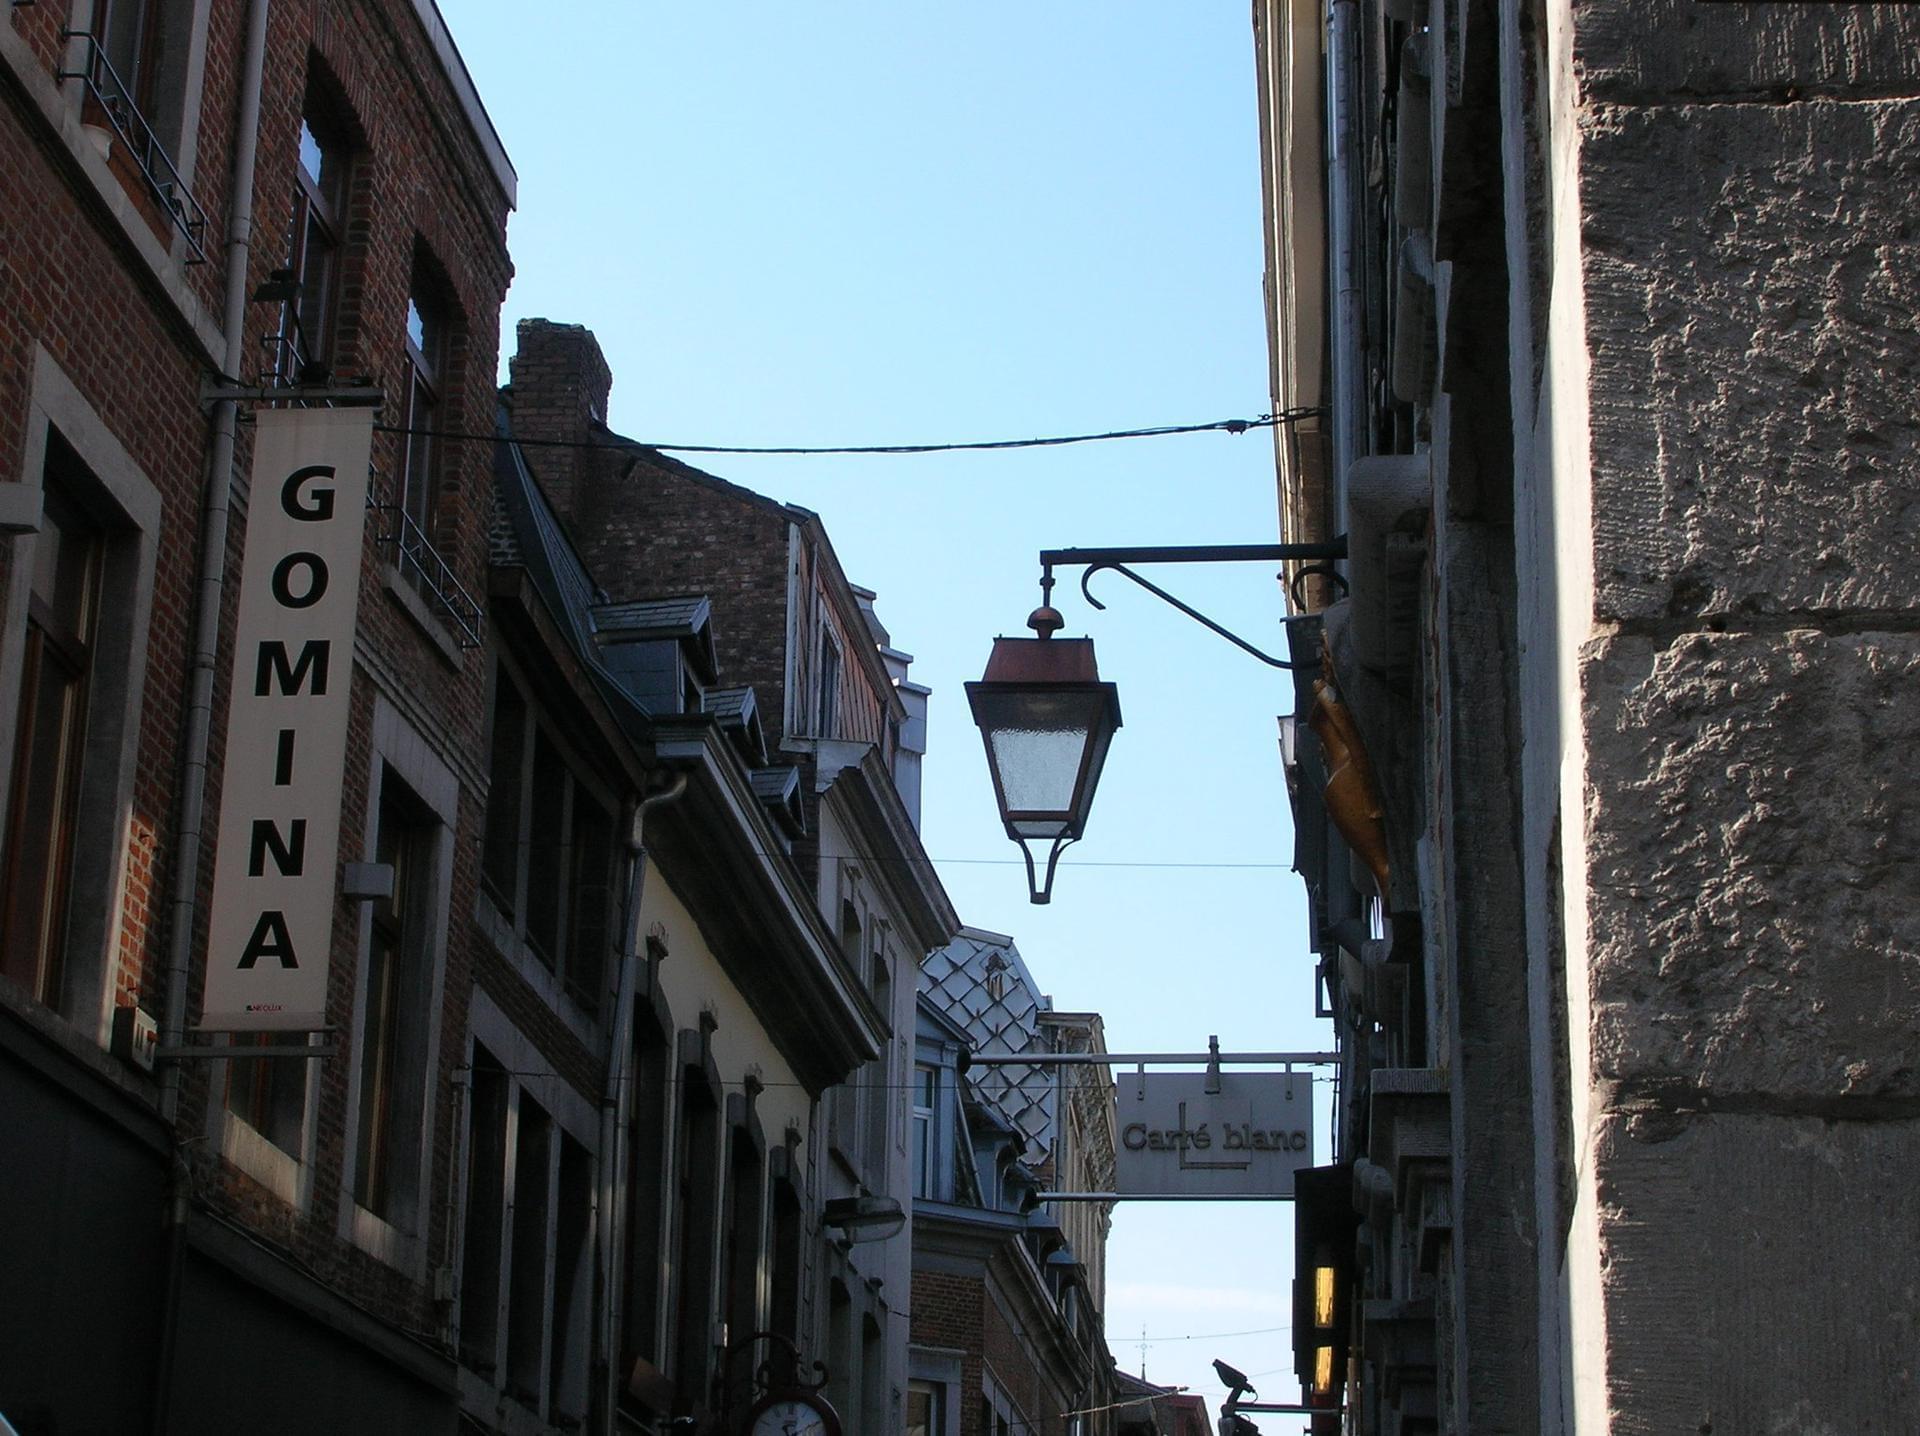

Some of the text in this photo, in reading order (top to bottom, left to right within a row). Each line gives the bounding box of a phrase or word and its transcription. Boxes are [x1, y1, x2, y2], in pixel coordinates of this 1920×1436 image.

[237, 465, 336, 970] GOMINA
[1122, 1122, 1307, 1150] Carré blanc
